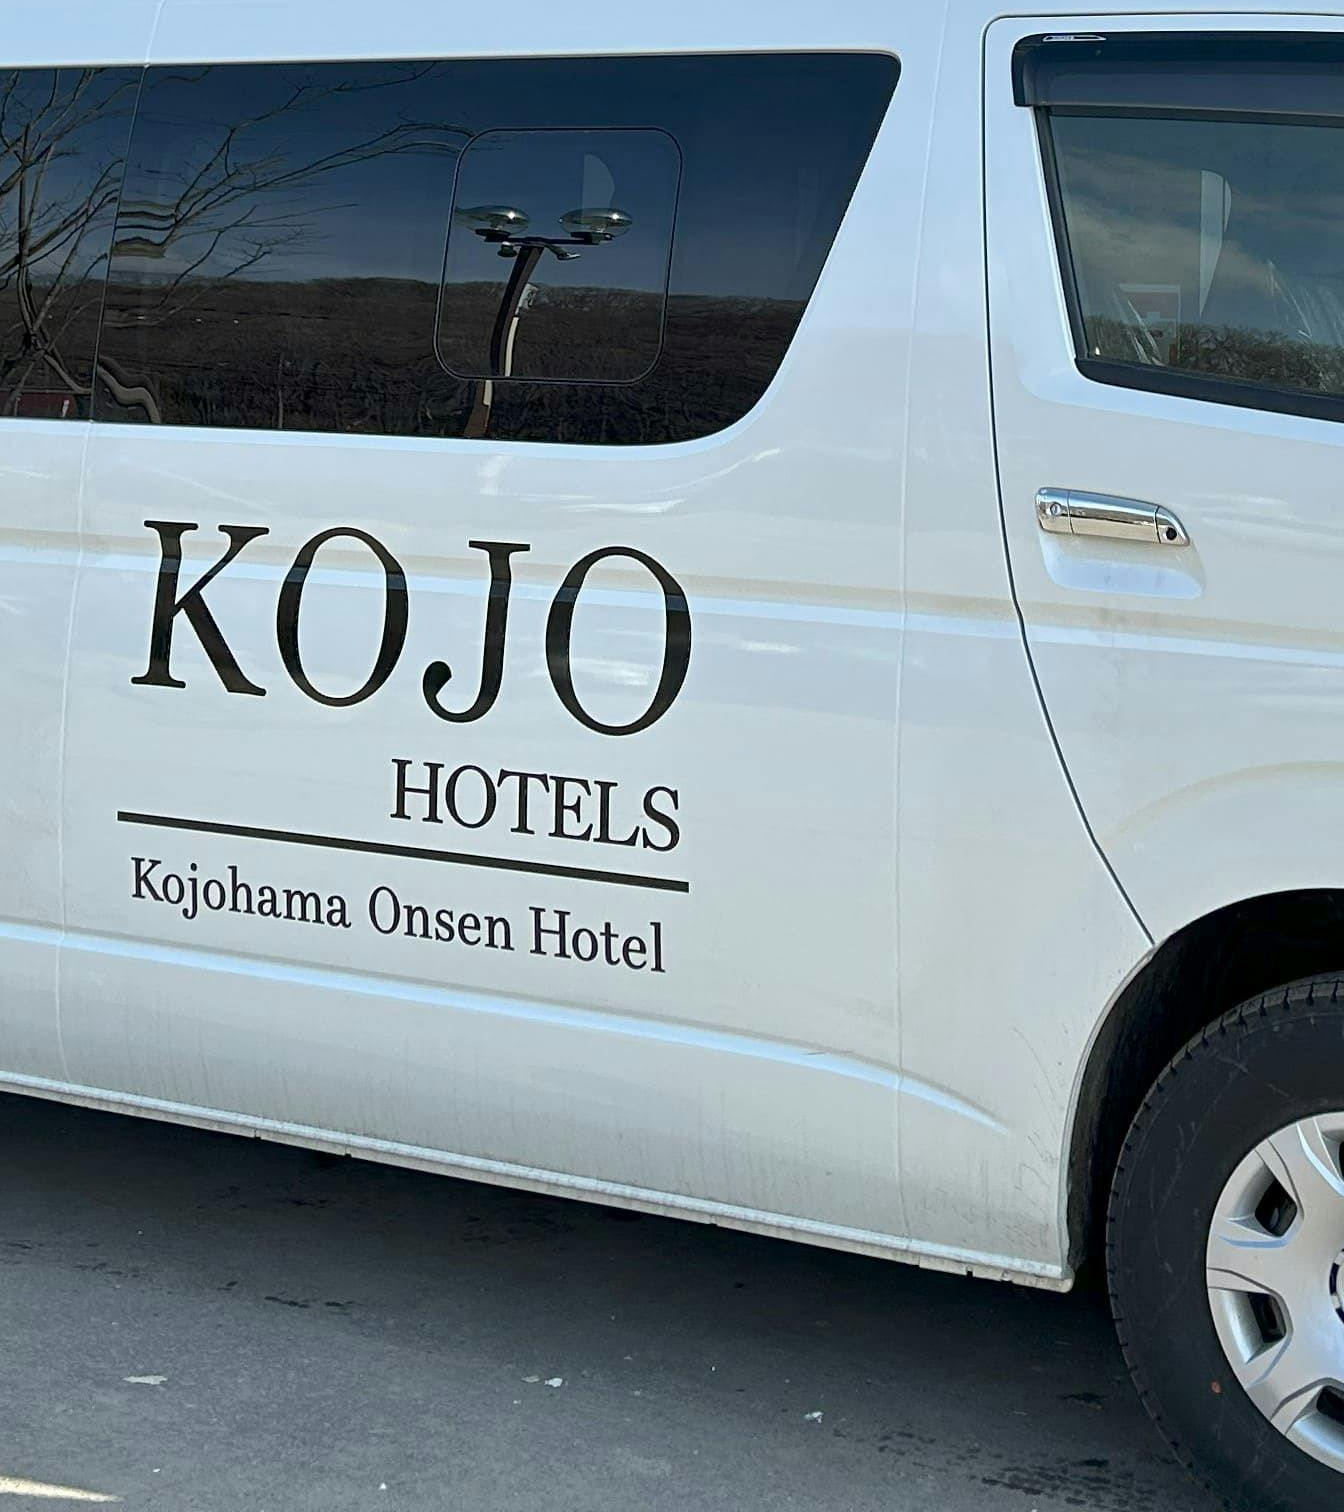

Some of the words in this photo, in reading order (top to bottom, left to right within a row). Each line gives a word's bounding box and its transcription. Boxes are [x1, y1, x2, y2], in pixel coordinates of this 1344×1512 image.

[131, 520, 692, 737] KOJO
[390, 758, 681, 852] HOTELS
[131, 857, 352, 929] Kojohama
[369, 887, 515, 951] Onsen
[529, 907, 666, 974] Hotel
